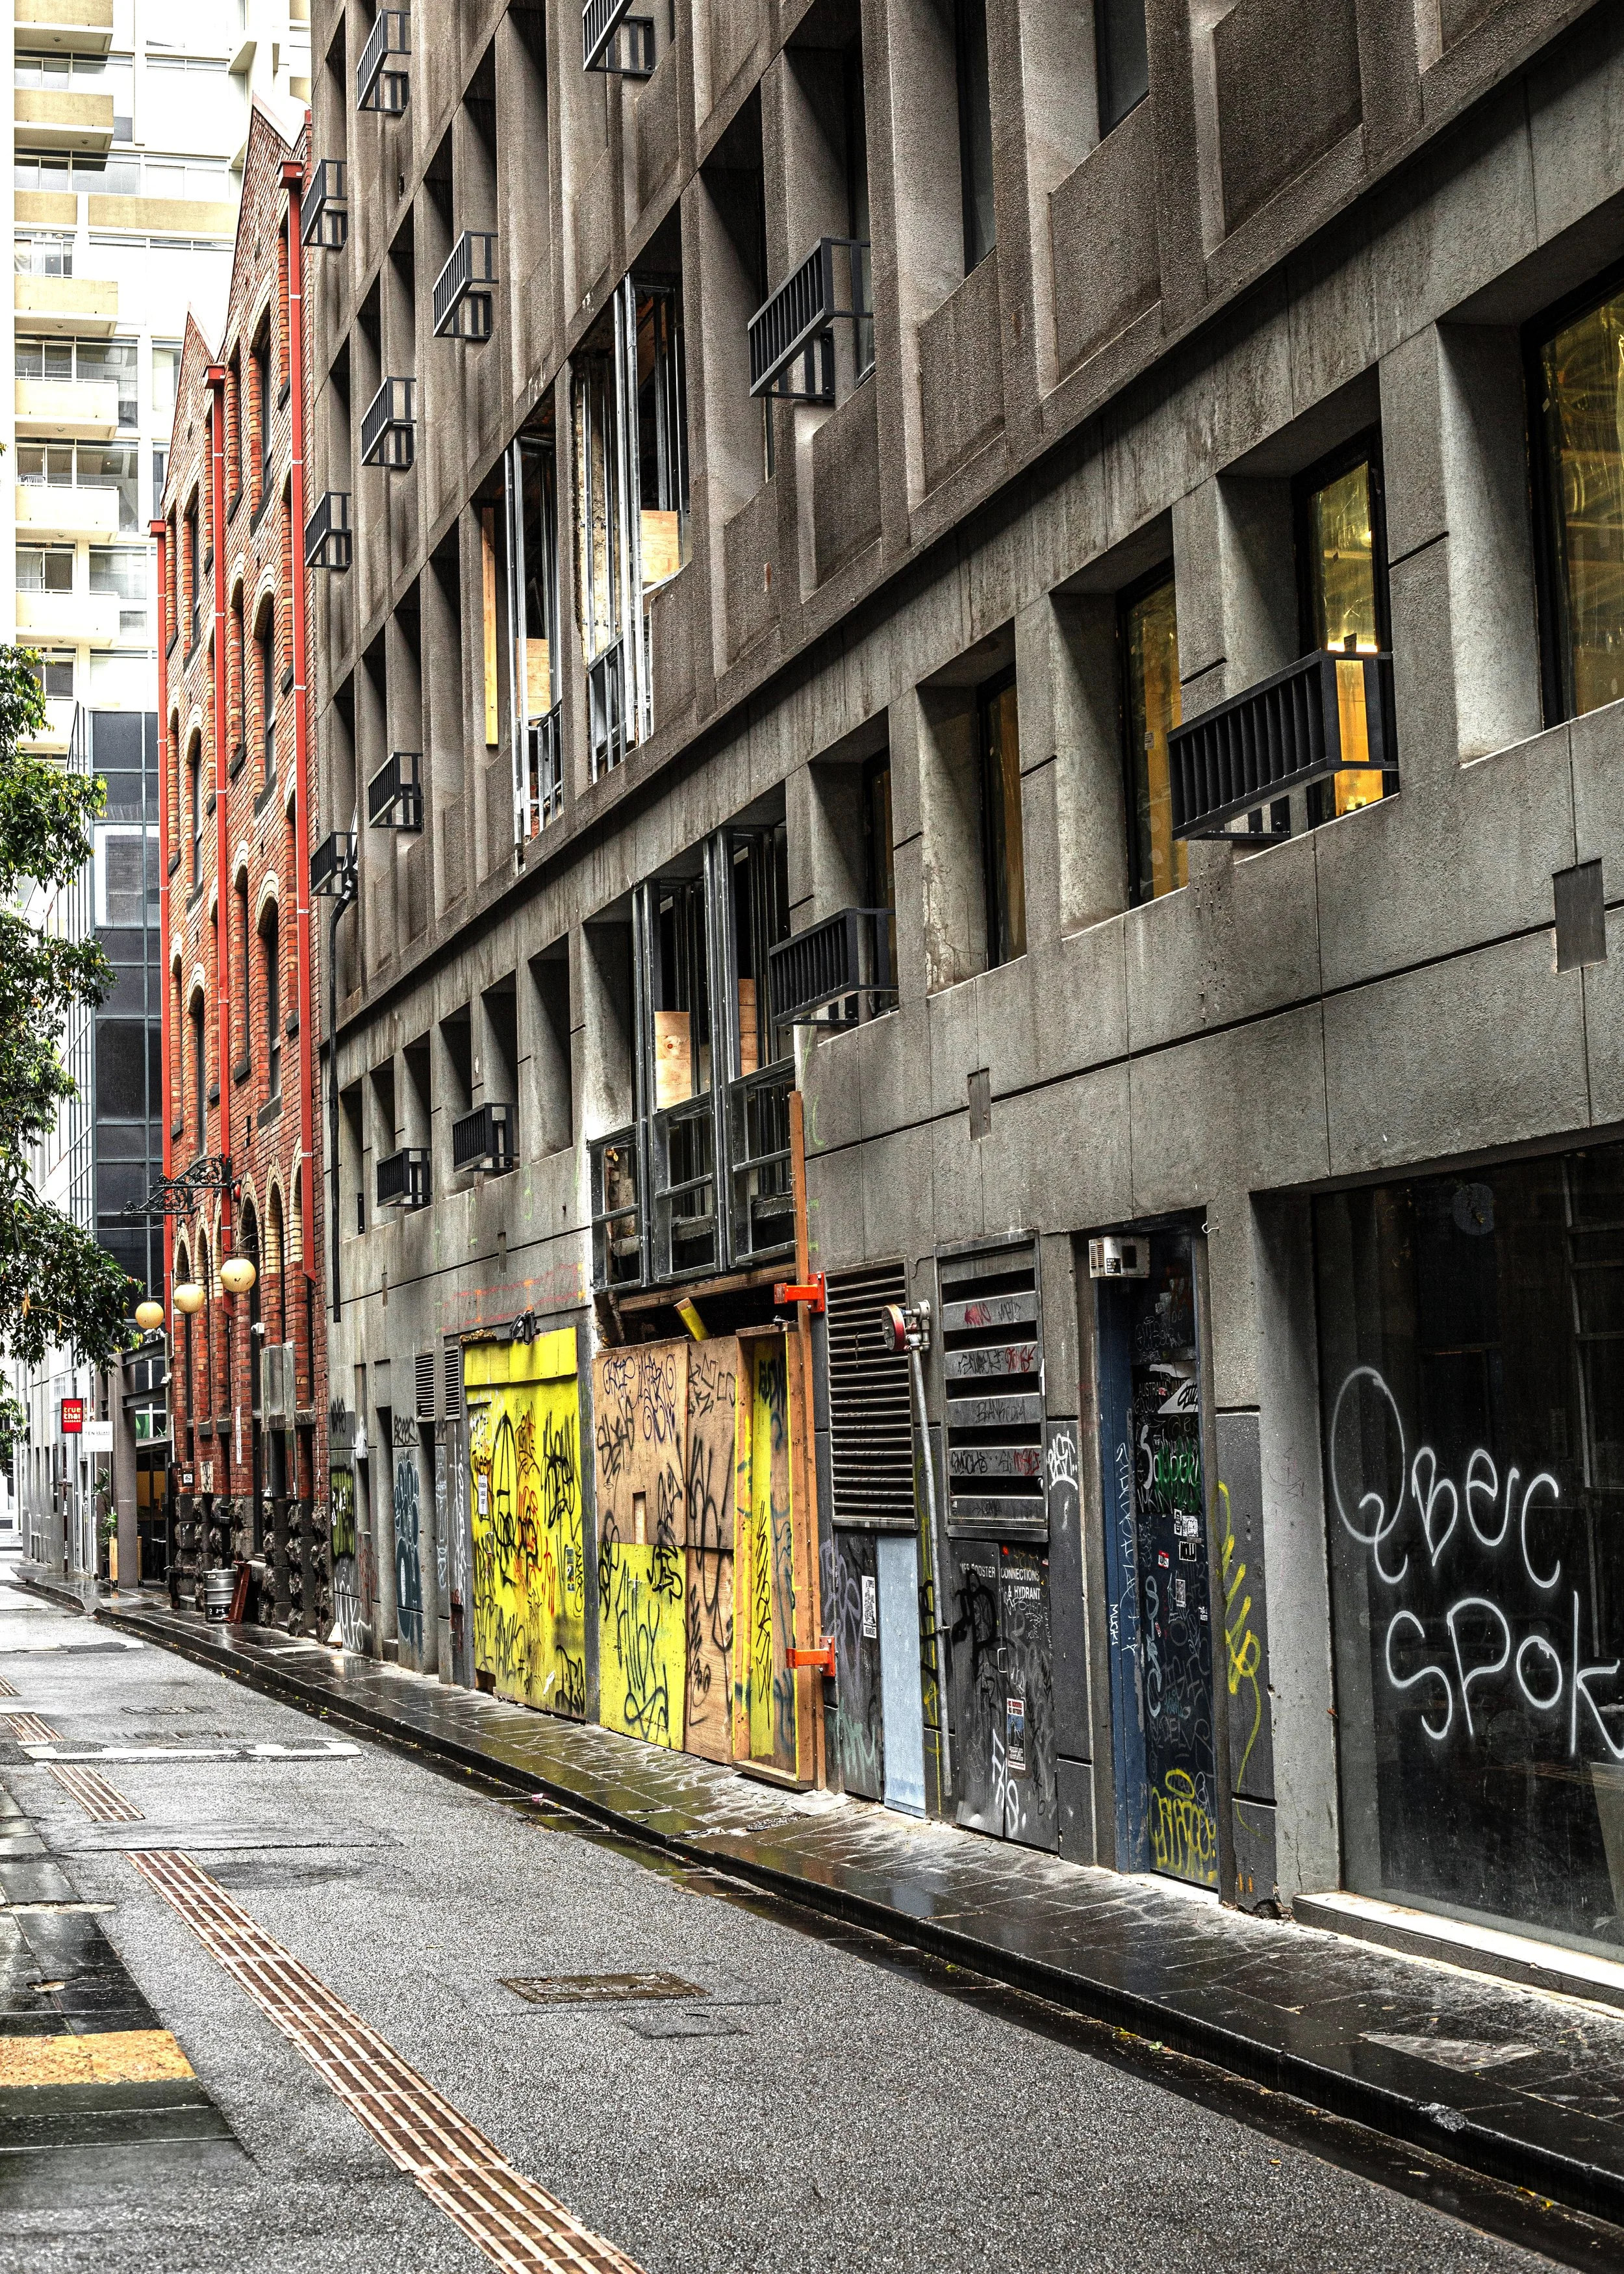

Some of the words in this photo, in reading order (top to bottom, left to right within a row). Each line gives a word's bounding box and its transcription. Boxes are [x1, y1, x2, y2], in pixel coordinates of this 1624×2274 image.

[1000, 1567, 1040, 1582] CONNECTIONS
[1008, 1585, 1013, 1598] &
[1014, 1585, 1041, 1600] HYDRANT
